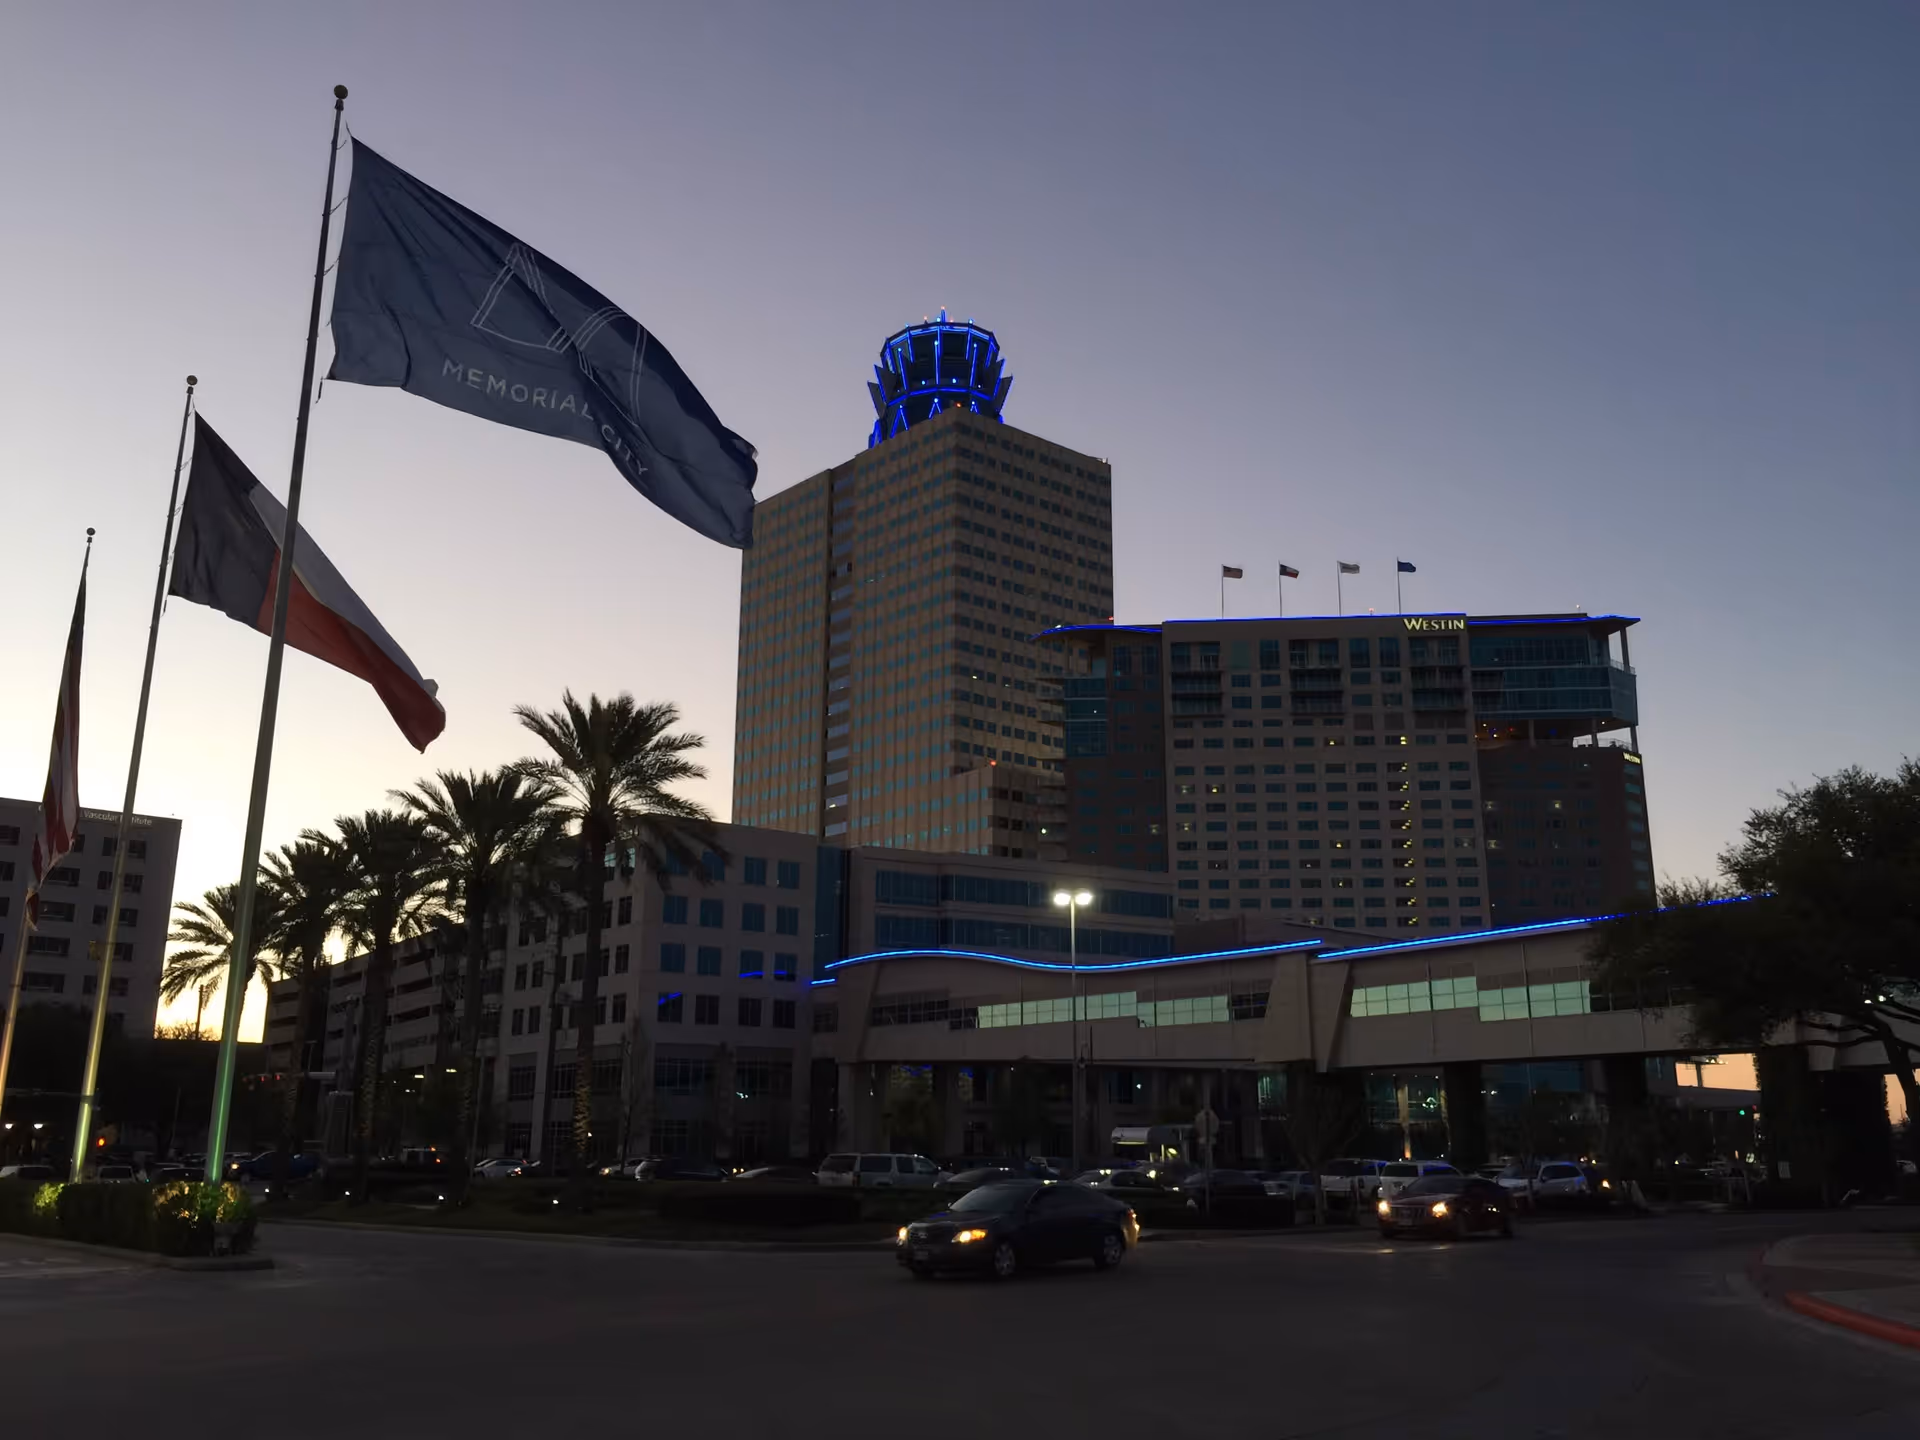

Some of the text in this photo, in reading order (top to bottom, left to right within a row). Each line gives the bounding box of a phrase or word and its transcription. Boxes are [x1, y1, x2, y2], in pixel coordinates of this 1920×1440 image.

[441, 358, 648, 475] MEMORIAL CITY
[1403, 617, 1465, 631] WESTIN
[120, 814, 153, 826] Ititute
